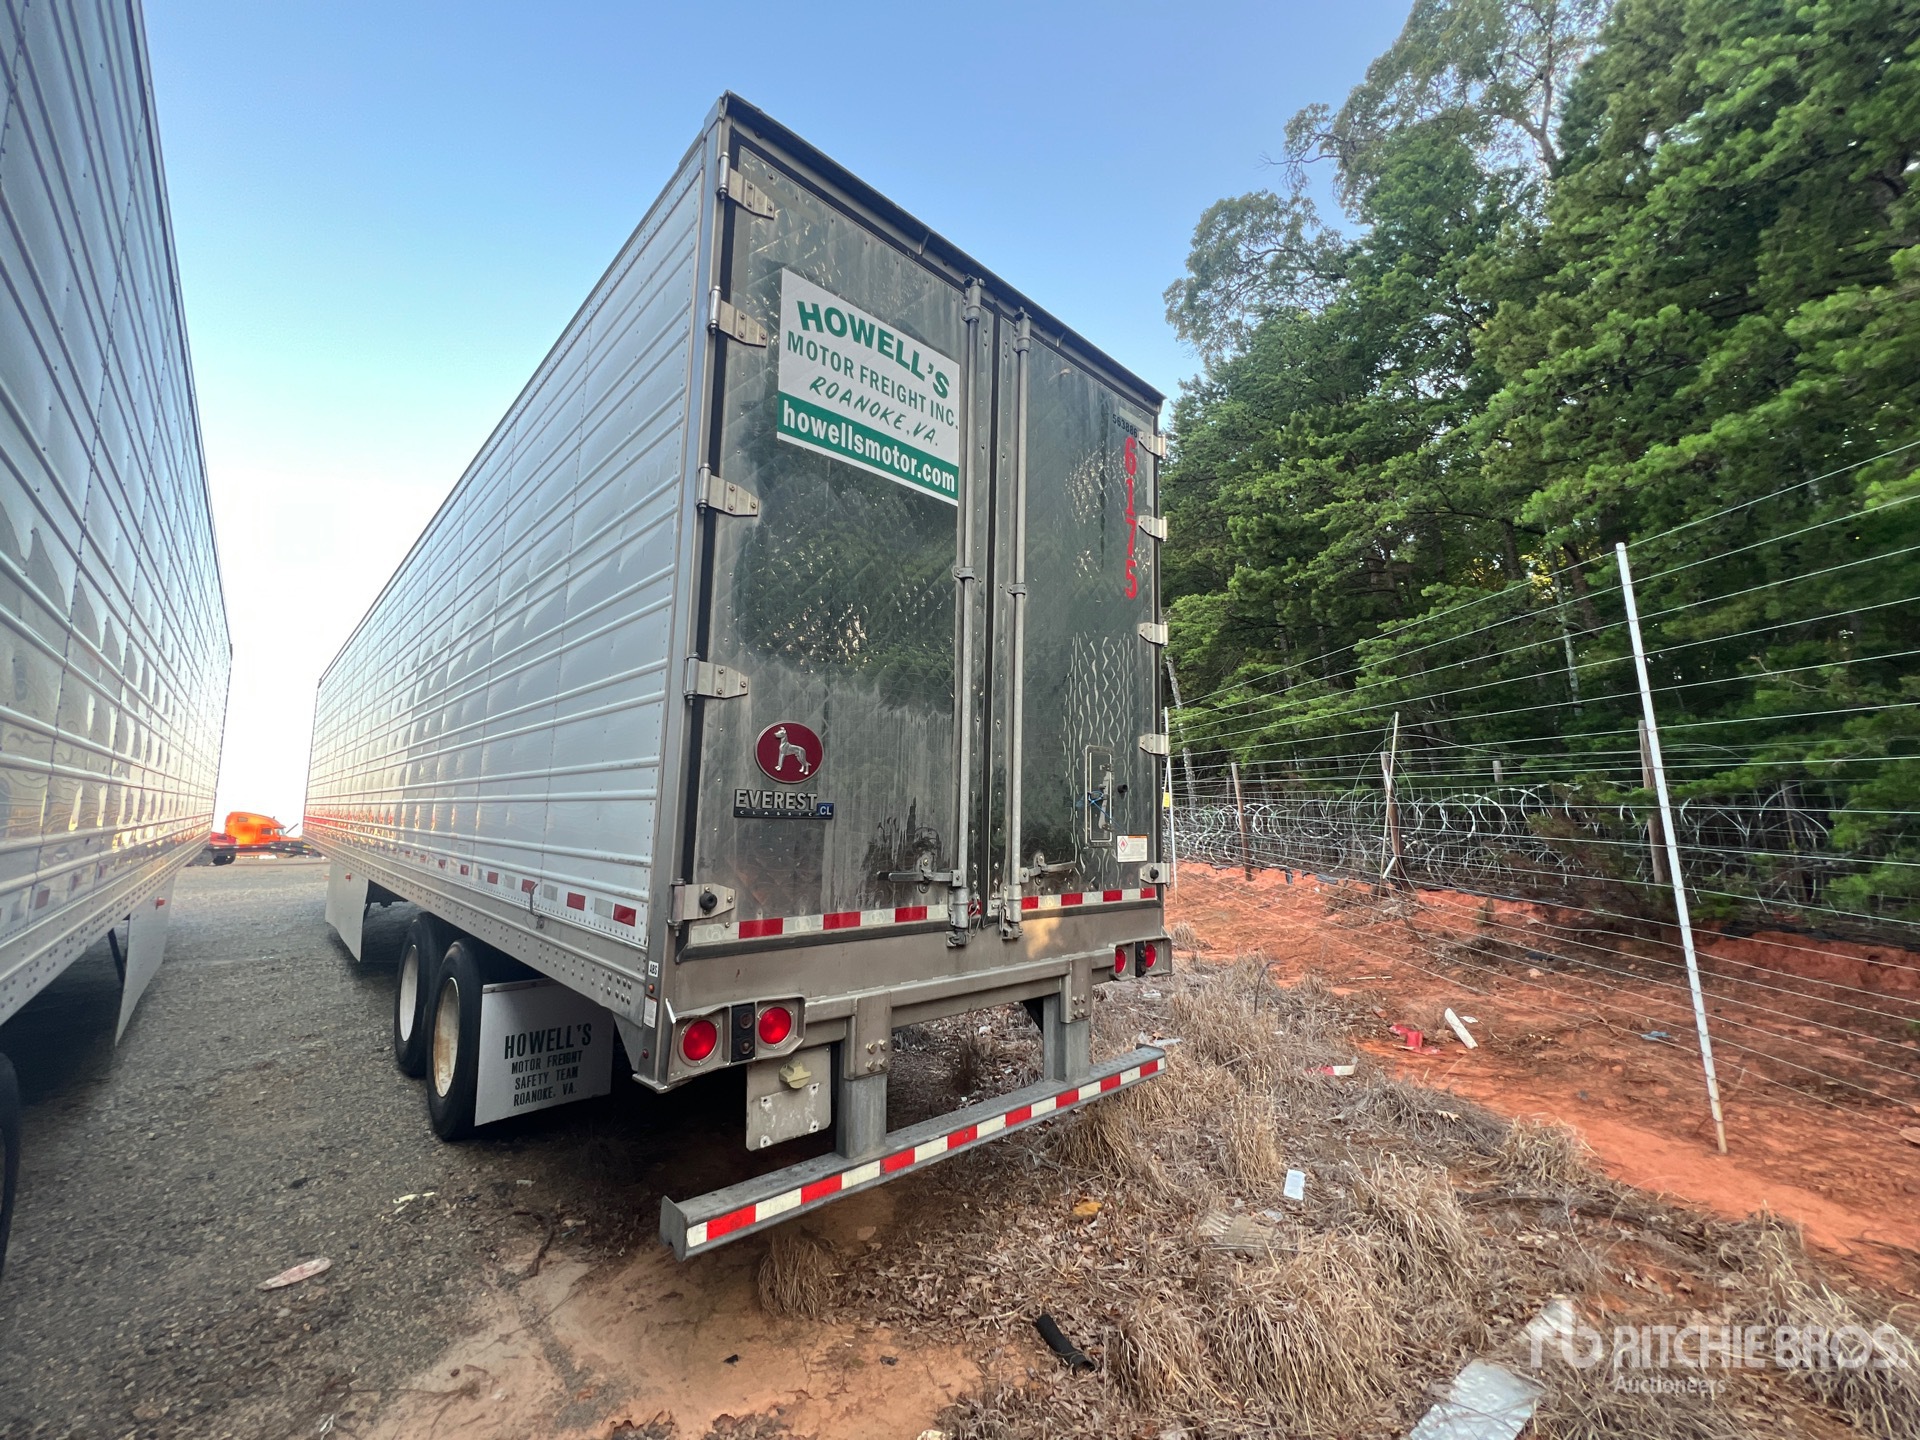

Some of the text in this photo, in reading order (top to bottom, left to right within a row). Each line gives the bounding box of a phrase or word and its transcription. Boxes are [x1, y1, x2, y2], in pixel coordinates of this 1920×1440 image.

[797, 300, 950, 399] HOWELL'S
[788, 331, 959, 430] MOTOR FREIGHT INC.
[783, 400, 955, 493] howellsmotor.com
[1124, 436, 1138, 599] 6175
[735, 789, 818, 810] EVEREST
[820, 806, 832, 815] CL
[504, 1023, 592, 1060] HOWELL'S
[511, 1050, 583, 1075] MOTOR FREIGHT
[514, 1066, 578, 1091] SAFETY TEAM
